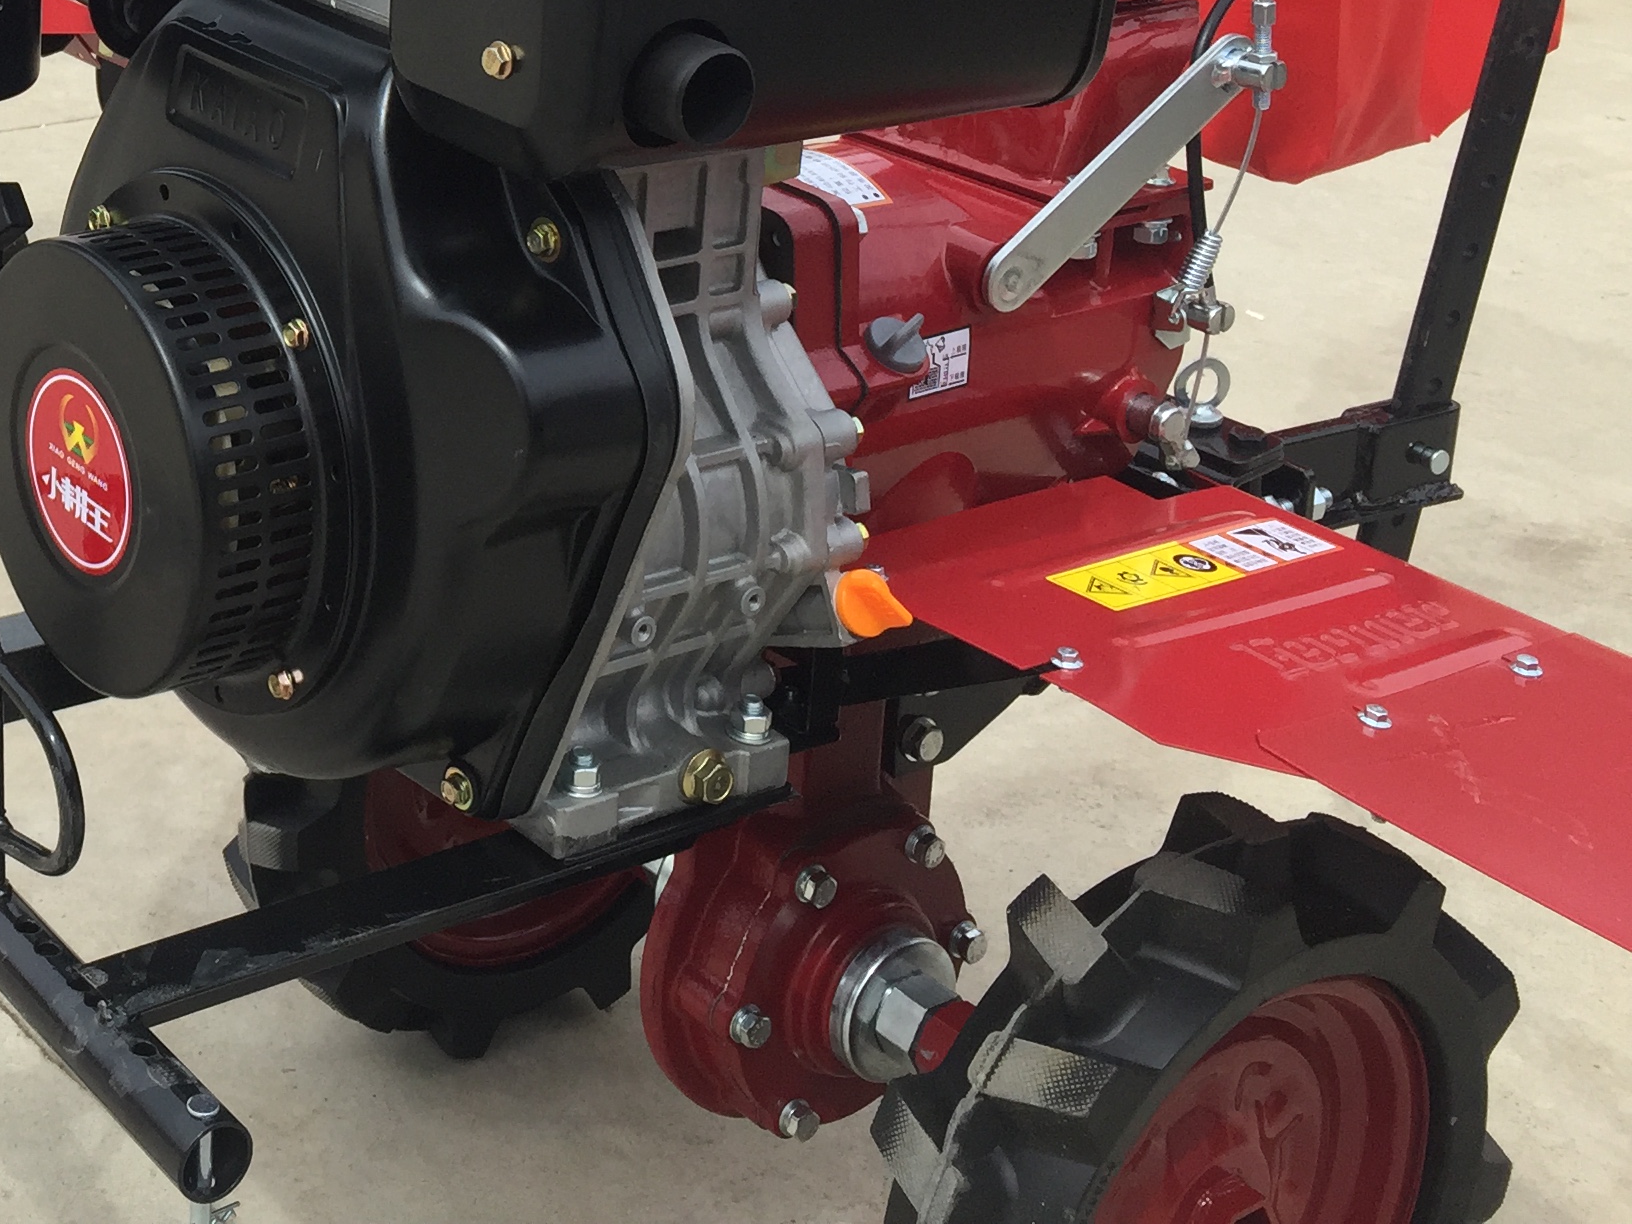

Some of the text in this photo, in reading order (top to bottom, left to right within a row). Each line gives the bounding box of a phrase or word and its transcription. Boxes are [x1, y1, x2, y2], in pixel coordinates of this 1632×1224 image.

[48, 442, 108, 492] XIAO GENG WANG
[41, 466, 113, 543] 小耕王
